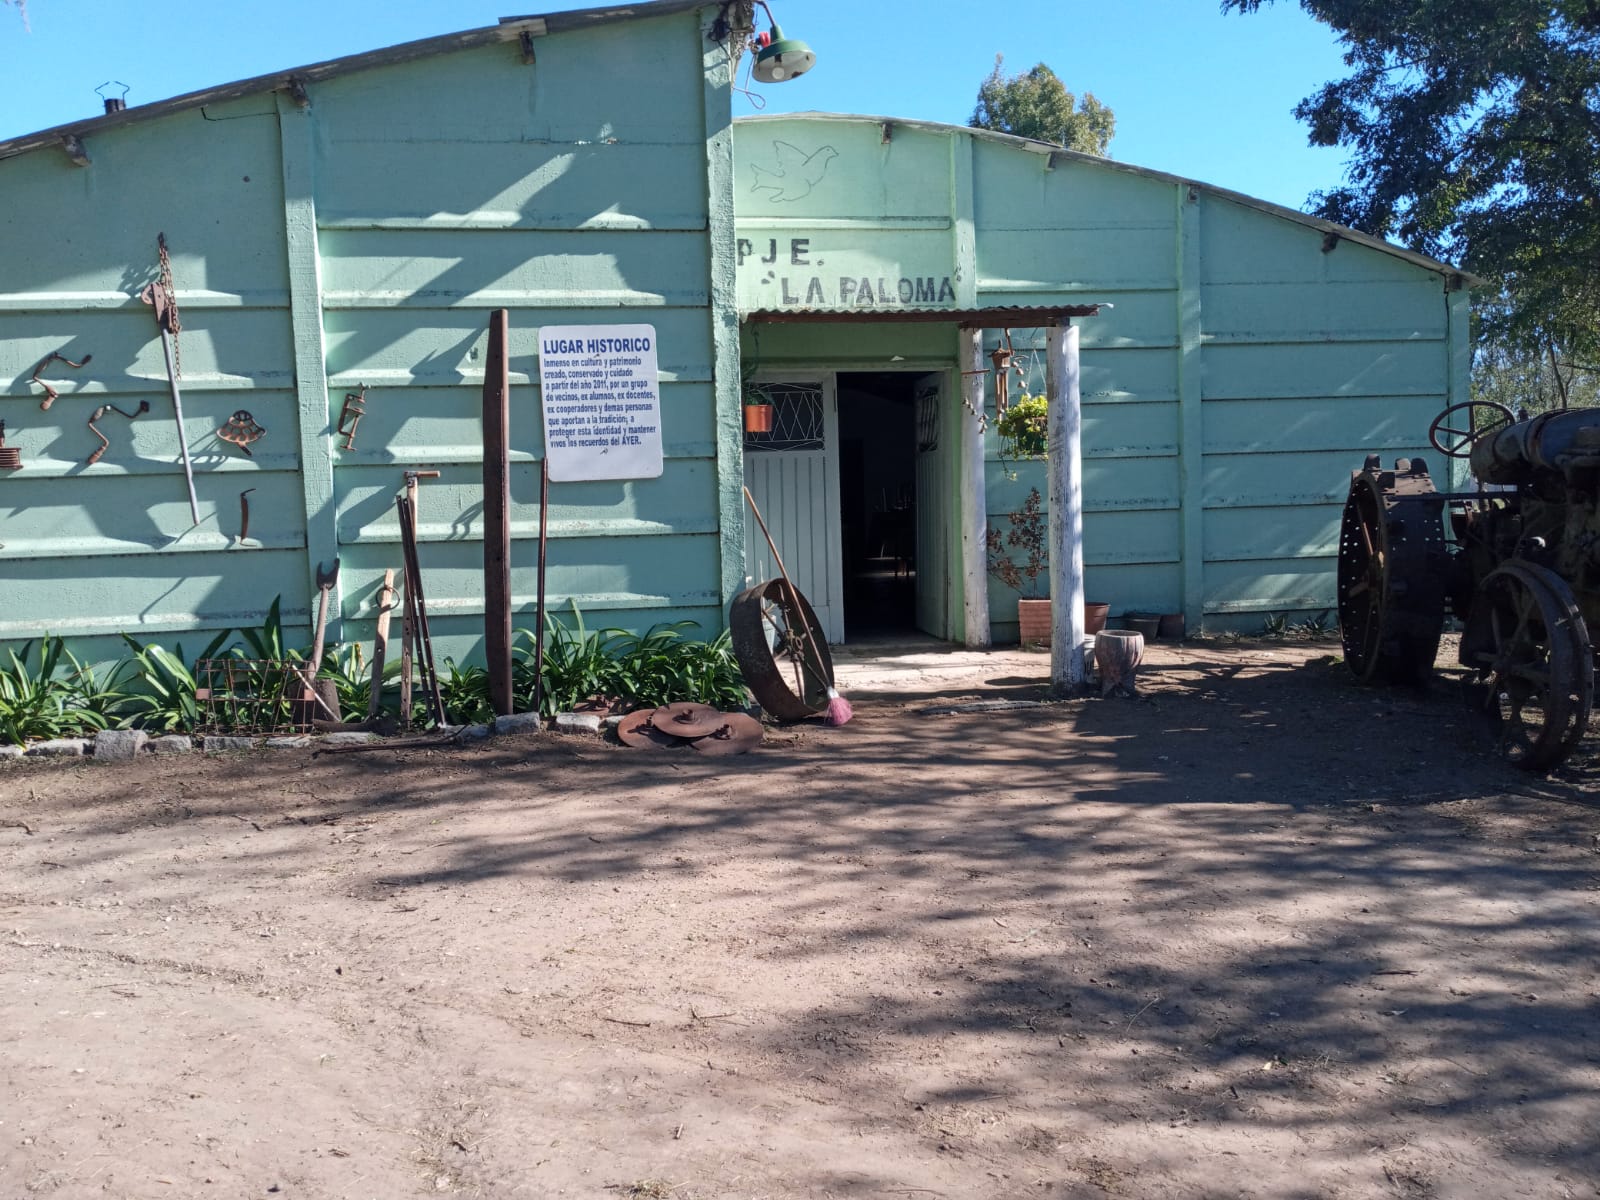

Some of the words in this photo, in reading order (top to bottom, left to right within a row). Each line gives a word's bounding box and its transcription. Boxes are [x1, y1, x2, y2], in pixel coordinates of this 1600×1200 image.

[544, 339, 584, 354] LUGAR
[587, 338, 650, 353] HISTORICO
[571, 359, 580, 367] en
[581, 357, 602, 367] cultura
[604, 359, 608, 368] y
[609, 356, 642, 368] patrimonio
[544, 369, 567, 380] creado,
[568, 368, 603, 378] conservado
[605, 370, 609, 380] y
[610, 368, 633, 377] cuidado
[551, 381, 569, 392] partir
[570, 380, 579, 390] del
[581, 379, 592, 389] año
[593, 379, 609, 390] 2011,
[610, 381, 619, 390] por
[631, 380, 648, 390] grupo
[546, 393, 553, 401] de
[555, 393, 580, 402] vecinos,
[589, 392, 616, 402] alumnos,
[626, 391, 656, 401] docentes,
[556, 404, 597, 415] cooperadores
[599, 405, 603, 414] y
[604, 403, 624, 412] demas
[625, 403, 653, 414] personas
[548, 418, 560, 427] que
[561, 416, 585, 427] aportan
[592, 415, 597, 424] la
[549, 428, 576, 438] proteger
[577, 427, 591, 436] esta
[593, 426, 621, 436] identidad
[623, 427, 627, 437] y
[628, 425, 656, 434] mantener
[550, 440, 566, 448] vivos
[568, 438, 577, 448] los
[578, 437, 609, 448] recuerdos
[611, 436, 619, 446] del
[622, 436, 642, 446] AYER.
